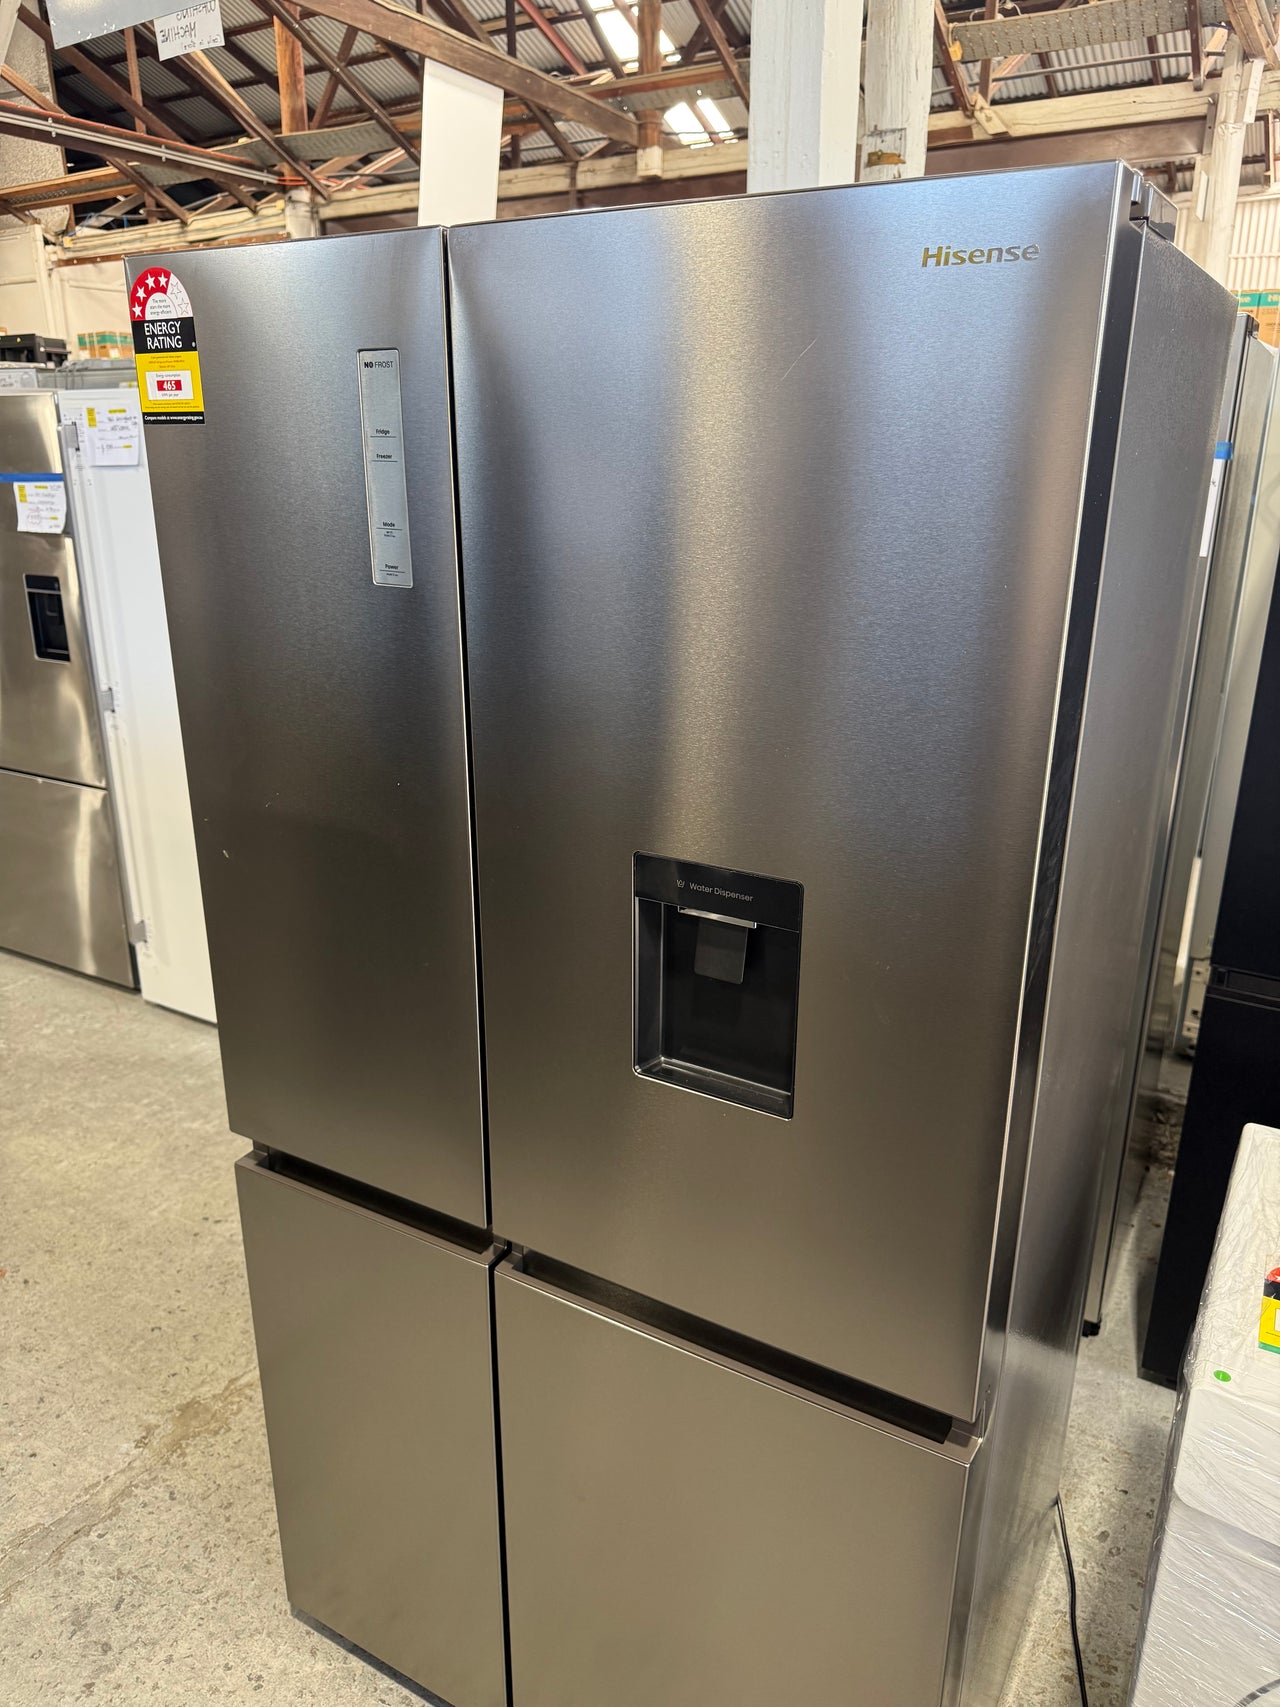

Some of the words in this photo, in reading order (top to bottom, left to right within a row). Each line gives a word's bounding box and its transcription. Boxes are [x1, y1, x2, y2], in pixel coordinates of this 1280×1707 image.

[921, 243, 1041, 268] Hisense
[144, 320, 181, 335] ENERGY
[146, 335, 182, 350] RATING
[374, 360, 394, 368] FROST
[163, 380, 176, 391] 465
[375, 428, 390, 436] Fridge
[689, 882, 713, 893] Water
[714, 887, 753, 902] Dispenser
